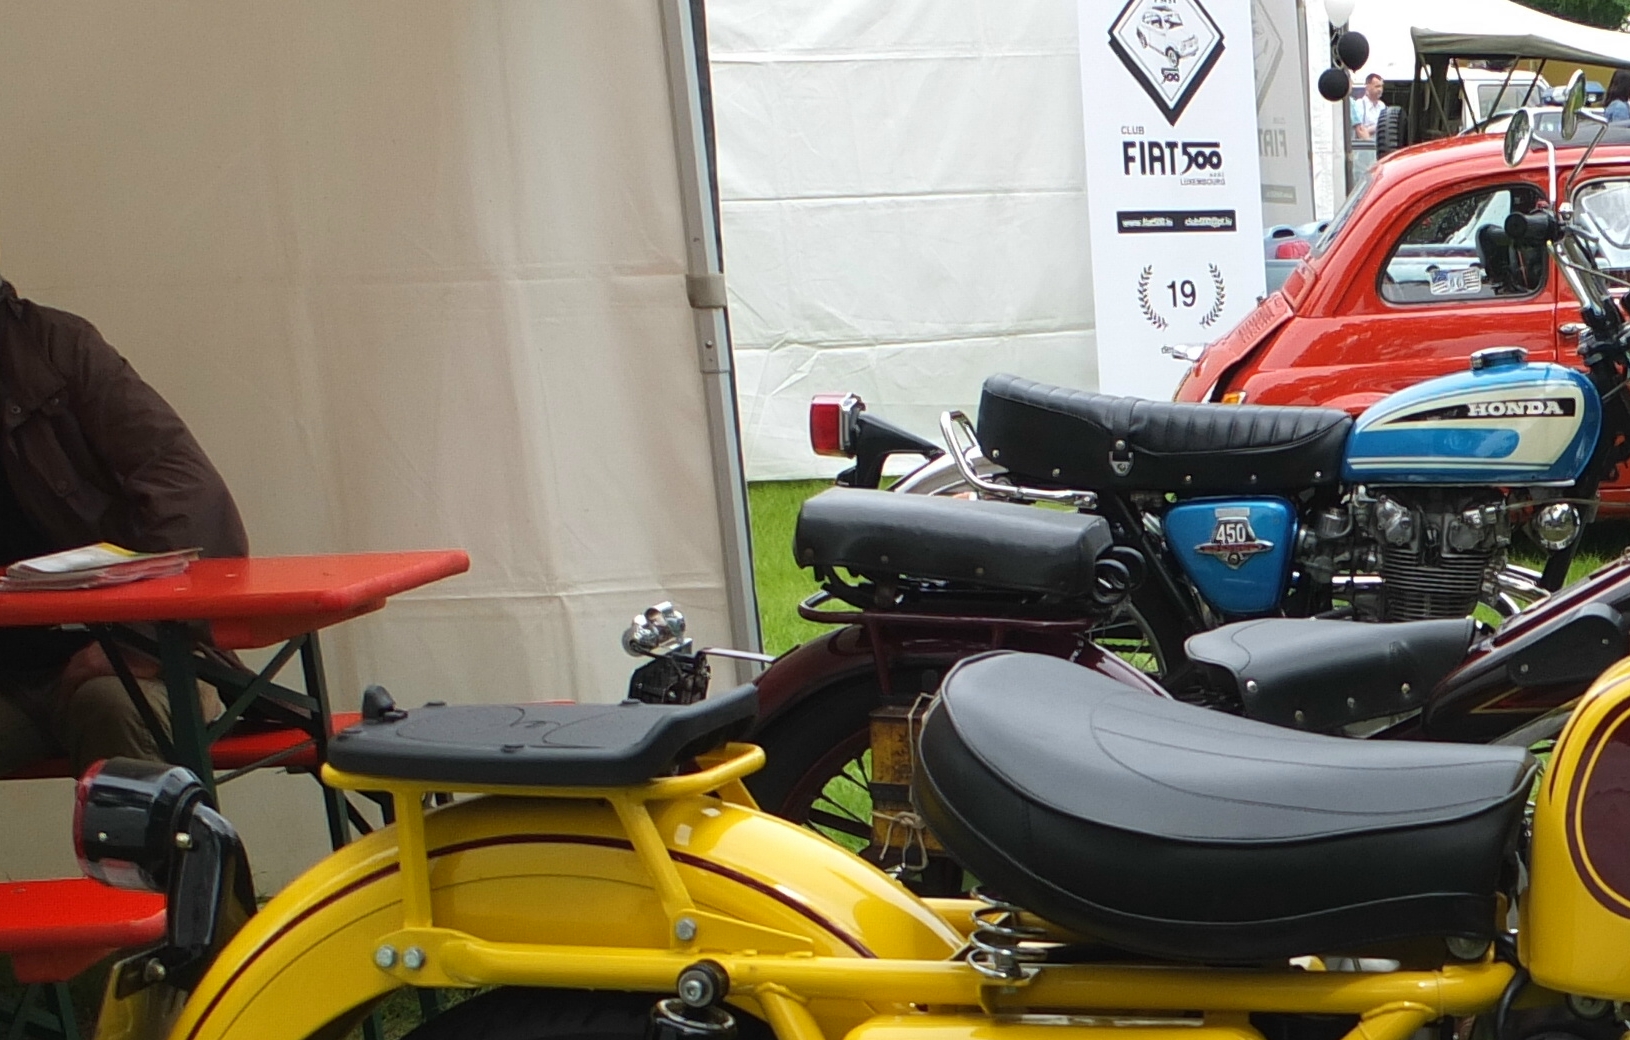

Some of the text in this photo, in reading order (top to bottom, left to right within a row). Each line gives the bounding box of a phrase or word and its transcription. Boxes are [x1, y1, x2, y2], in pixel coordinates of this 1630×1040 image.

[1121, 126, 1145, 135] CLUB
[1122, 141, 1222, 175] FIAT 500
[1167, 280, 1197, 308] 19
[1467, 400, 1564, 417] HONDA
[1216, 523, 1246, 543] 450
